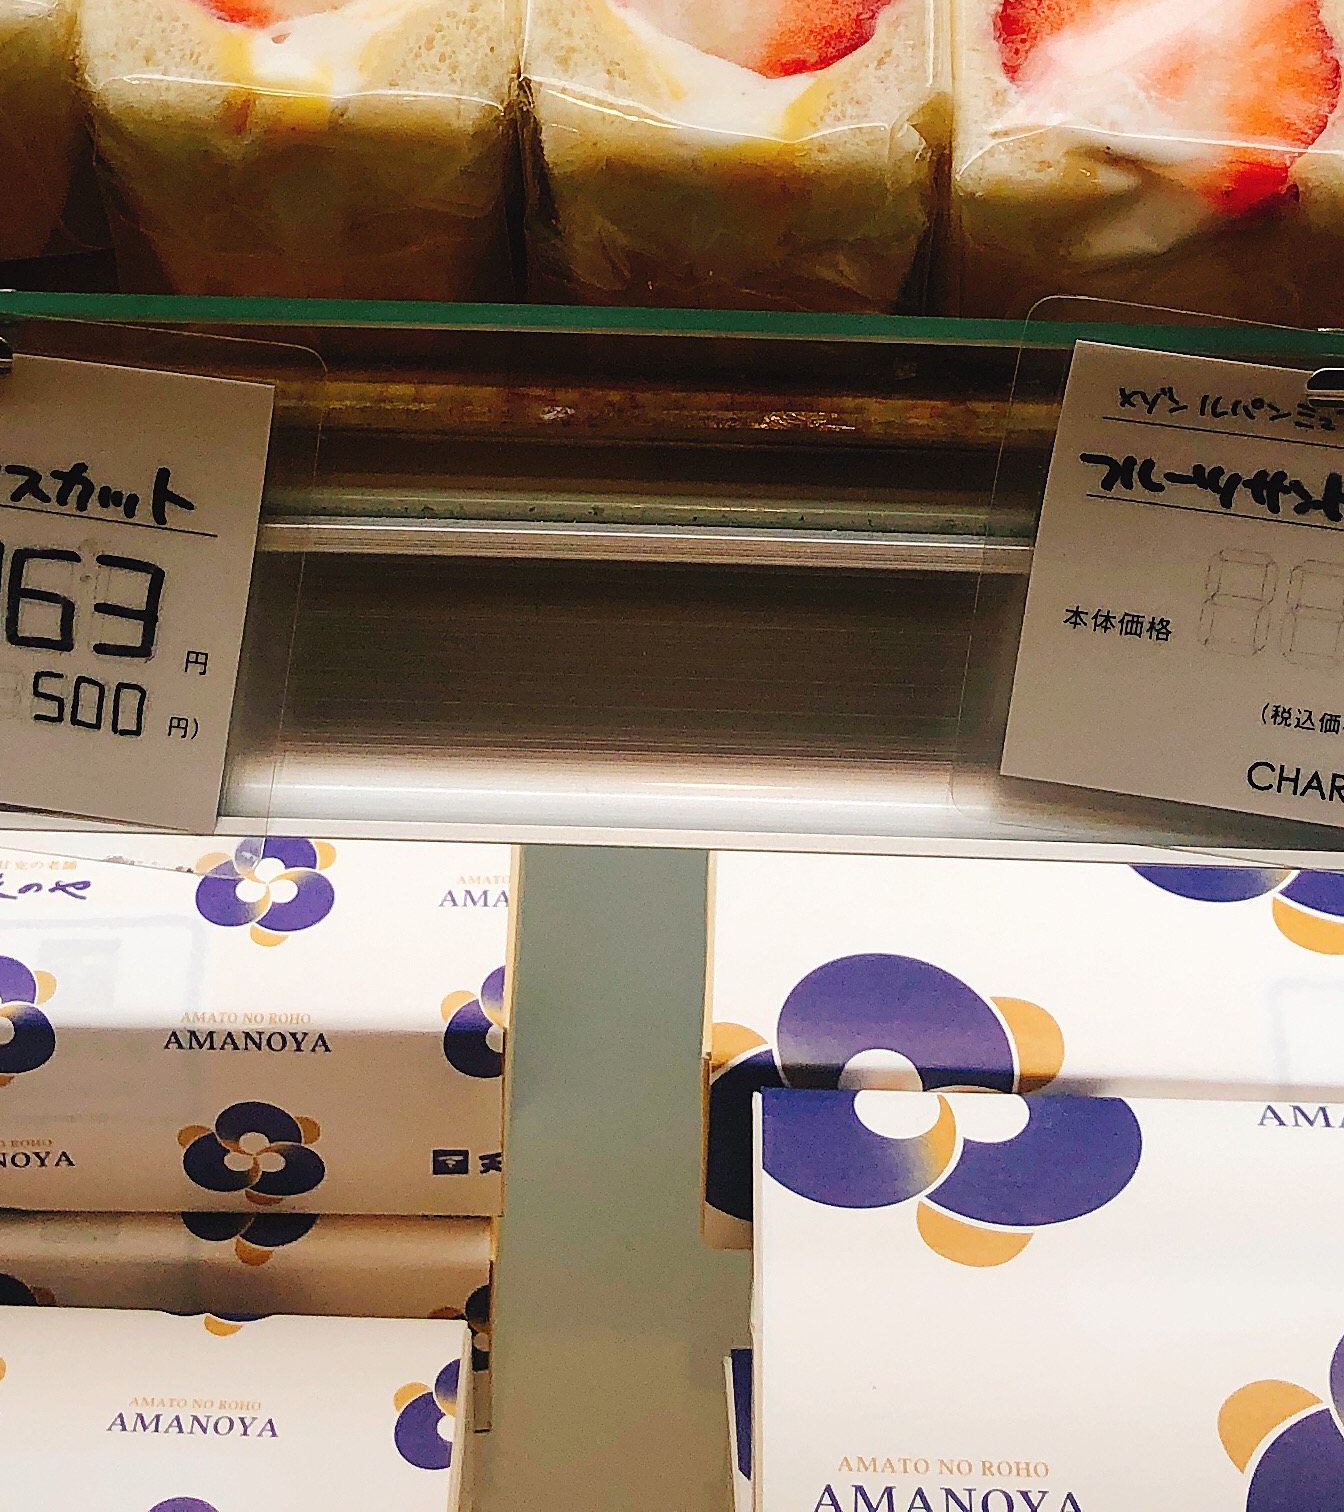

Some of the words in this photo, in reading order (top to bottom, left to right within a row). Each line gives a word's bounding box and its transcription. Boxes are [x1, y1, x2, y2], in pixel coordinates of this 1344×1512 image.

[1063, 606, 1173, 643] 本体価格
[183, 650, 210, 675] 円
[32, 669, 148, 737] 500
[167, 714, 200, 741] 円)
[181, 1012, 238, 1025] AMATO
[243, 1013, 265, 1025] NO
[163, 1030, 332, 1053] AMANOYA
[129, 1396, 188, 1407] AMATO
[193, 1398, 214, 1409] NO
[105, 1411, 279, 1439] AMANOYA
[838, 1456, 930, 1475] AMATO
[938, 1458, 973, 1476] NO
[981, 1460, 1050, 1478] ROHO
[814, 1484, 1083, 1512] AMANOYA
